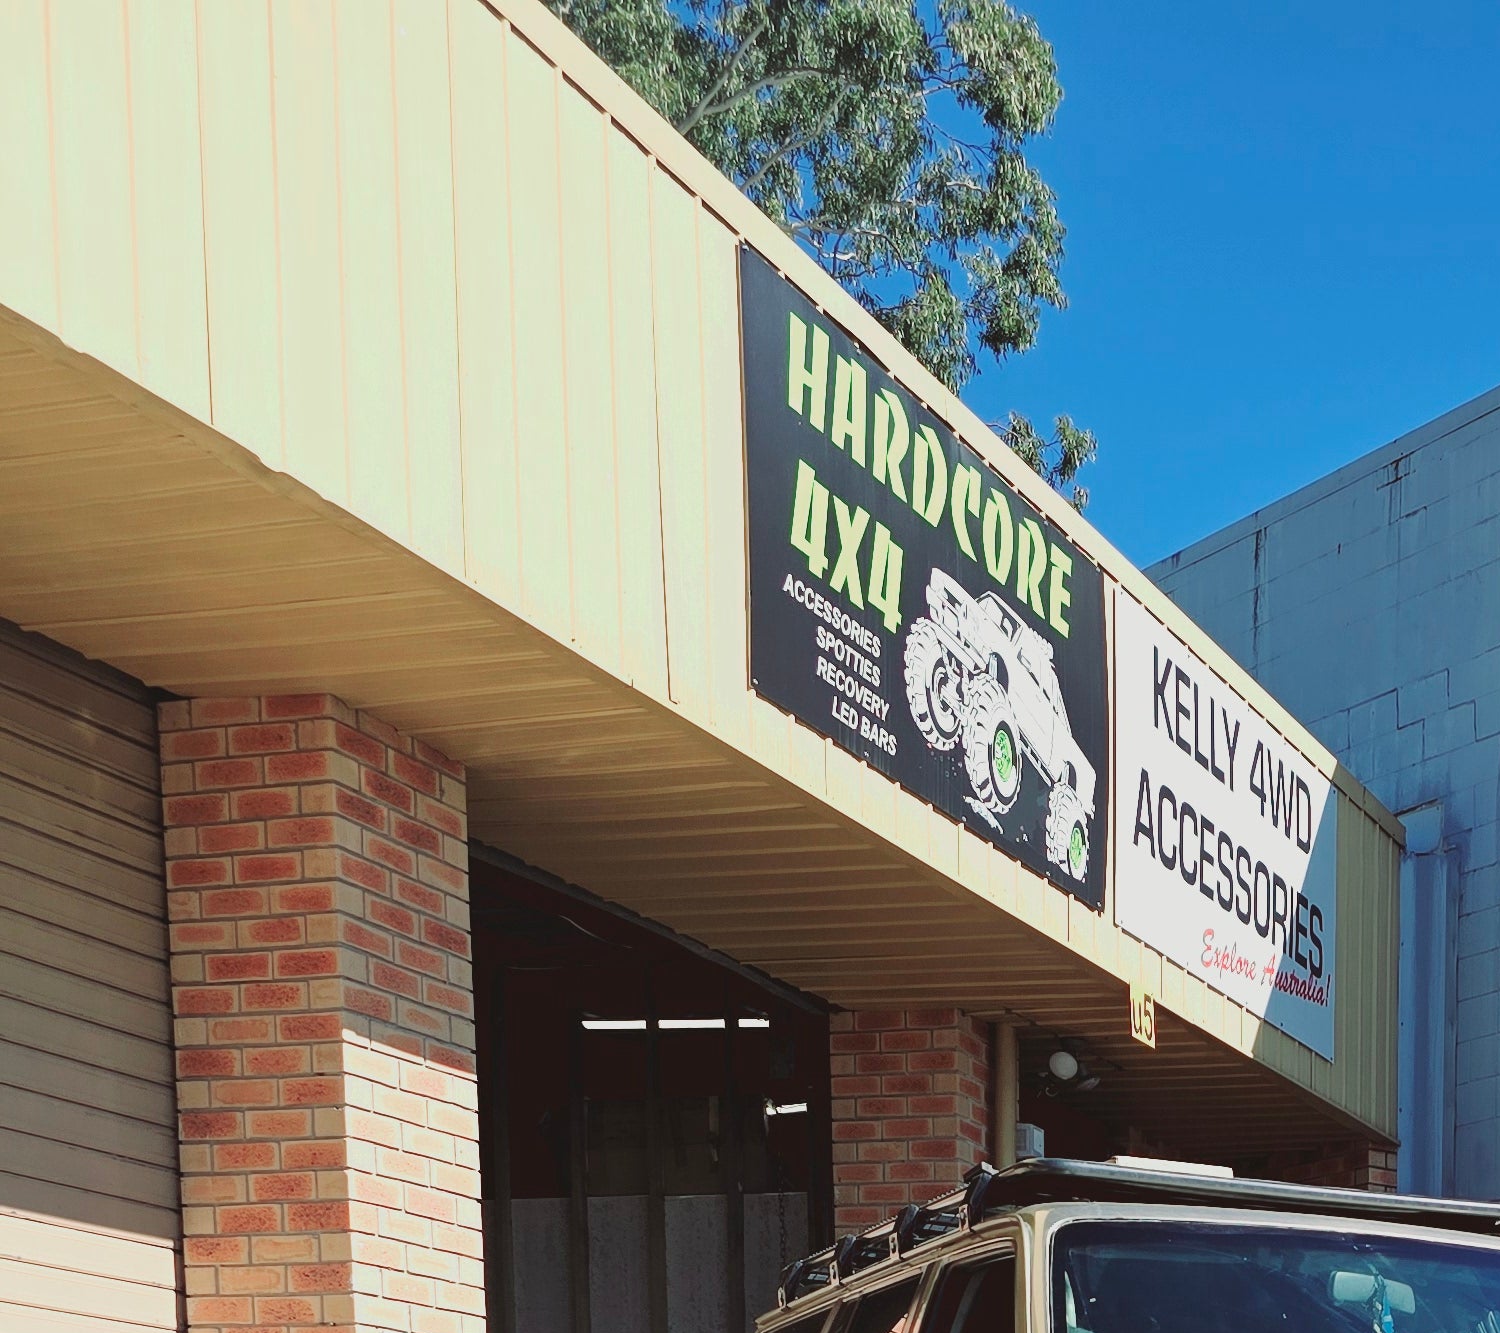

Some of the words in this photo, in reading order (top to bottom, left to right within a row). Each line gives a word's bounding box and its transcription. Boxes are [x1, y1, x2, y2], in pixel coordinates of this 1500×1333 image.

[788, 310, 1073, 639] HARDCORE
[790, 458, 905, 633] 4X4
[782, 573, 882, 658] ACCESSORIES
[816, 625, 881, 687] SPOTTIES
[816, 655, 890, 722] RECOVERY
[832, 695, 859, 730] LED
[860, 716, 898, 756] BARS
[1152, 644, 1243, 791] KELLY
[1248, 746, 1313, 856] 4WD
[1132, 768, 1326, 979] ACCESSORIES
[1201, 928, 1256, 980] Explore
[1261, 953, 1331, 1007] Australia!
